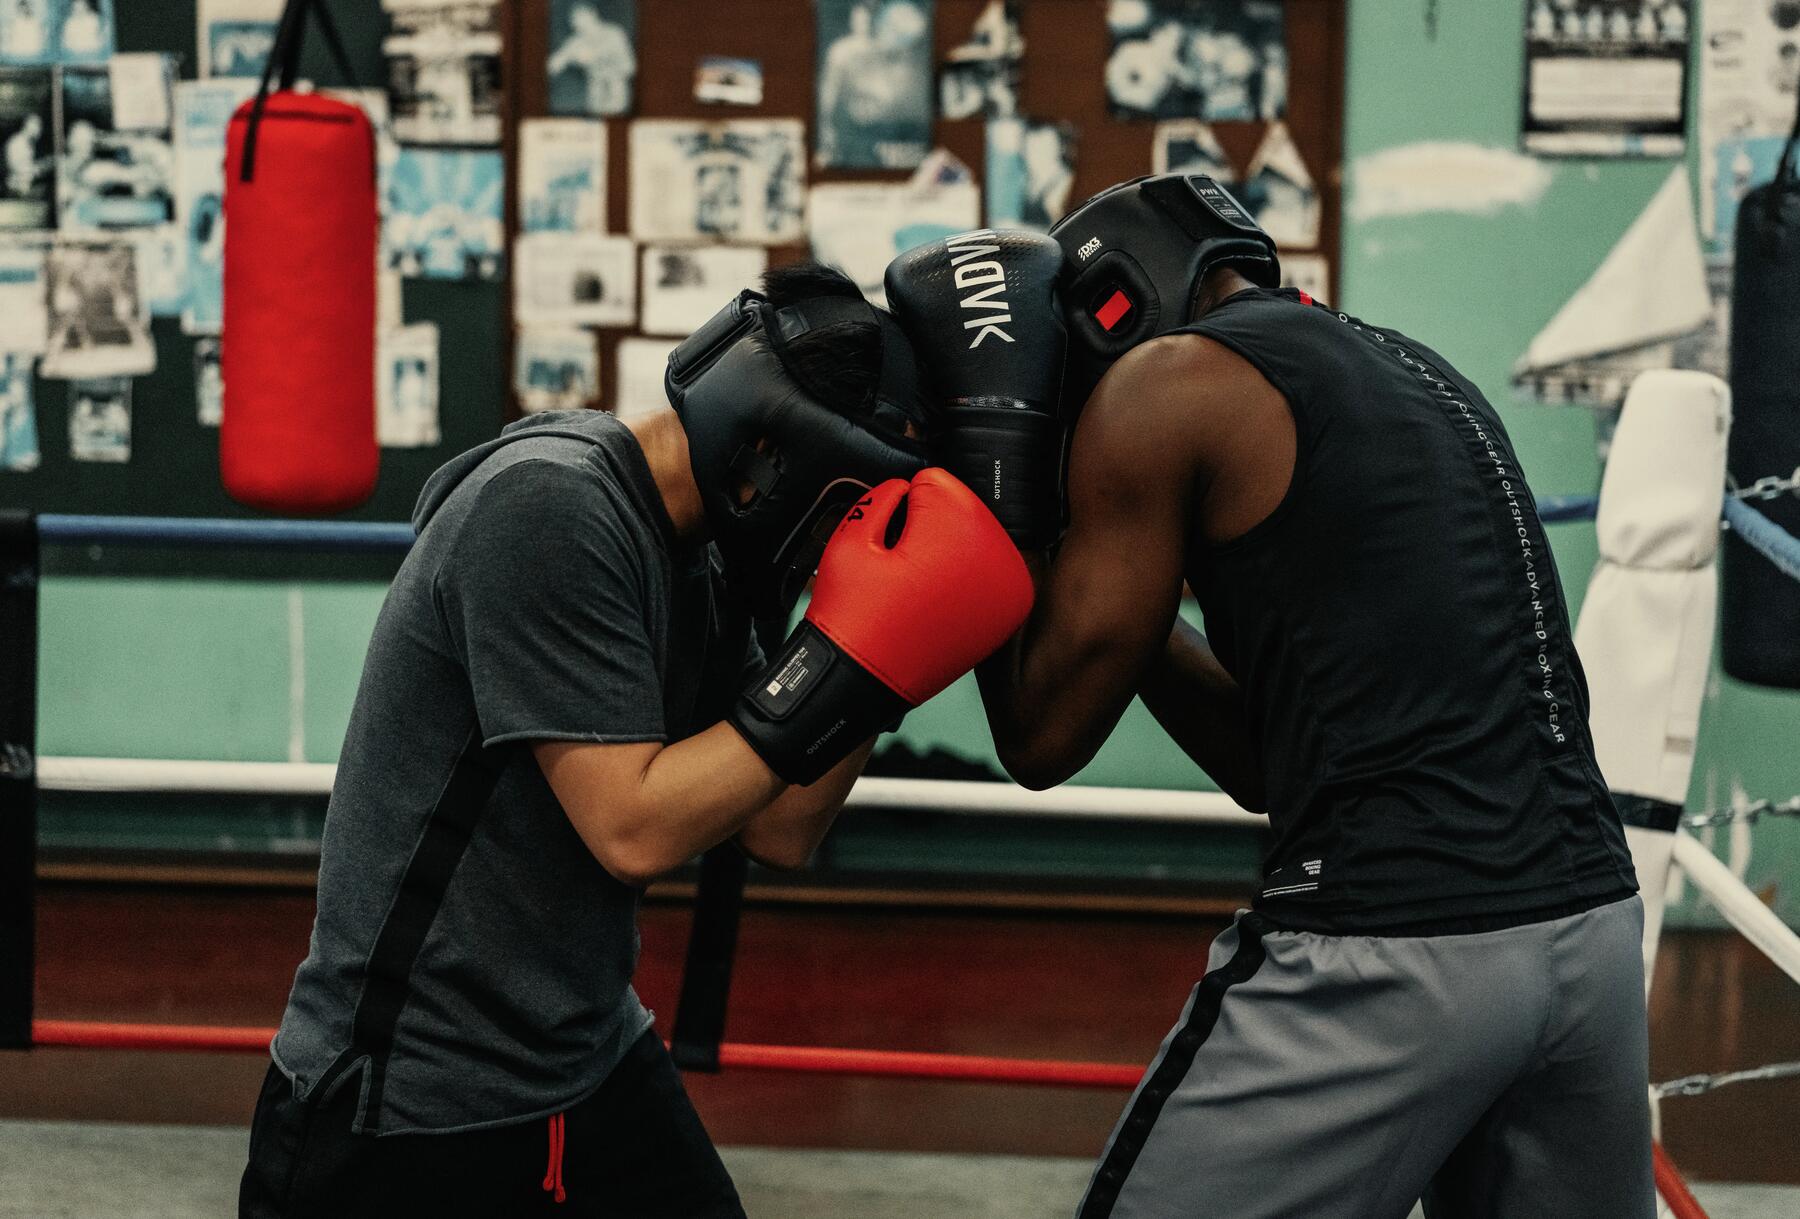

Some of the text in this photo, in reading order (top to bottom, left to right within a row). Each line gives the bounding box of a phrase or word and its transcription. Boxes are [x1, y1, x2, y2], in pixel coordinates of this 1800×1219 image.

[1485, 441, 1506, 475] GEAR
[1501, 480, 1533, 558] OUTSHOCK
[1526, 560, 1548, 640] ADVANCED
[1548, 702, 1566, 743] GEAR
[806, 719, 847, 755] OUTSHOCK
